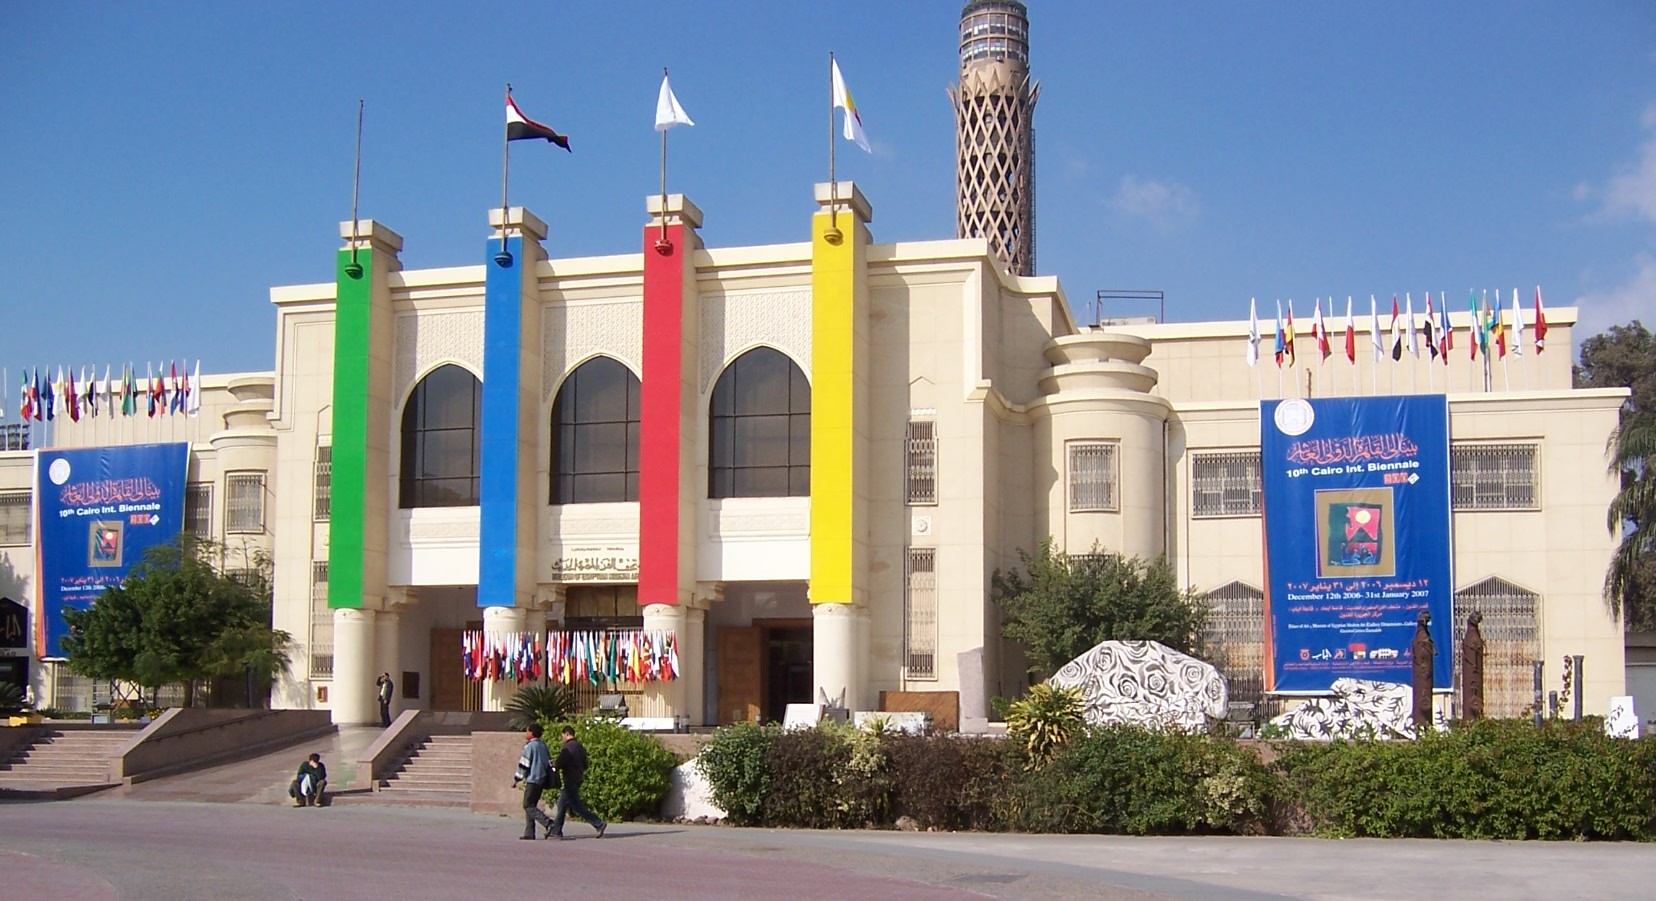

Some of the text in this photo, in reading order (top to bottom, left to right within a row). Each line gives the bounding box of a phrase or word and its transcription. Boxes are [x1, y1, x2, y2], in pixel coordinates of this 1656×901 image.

[1286, 460, 1420, 478] 10th Cairo Int. Biennale
[59, 502, 161, 518] 10th Cairo Int. Biennale
[1288, 593, 1324, 601] December
[1326, 592, 1341, 600] 12th
[1365, 591, 1381, 599] 31st
[1382, 590, 1409, 599] January
[1411, 590, 1429, 598] 2007
